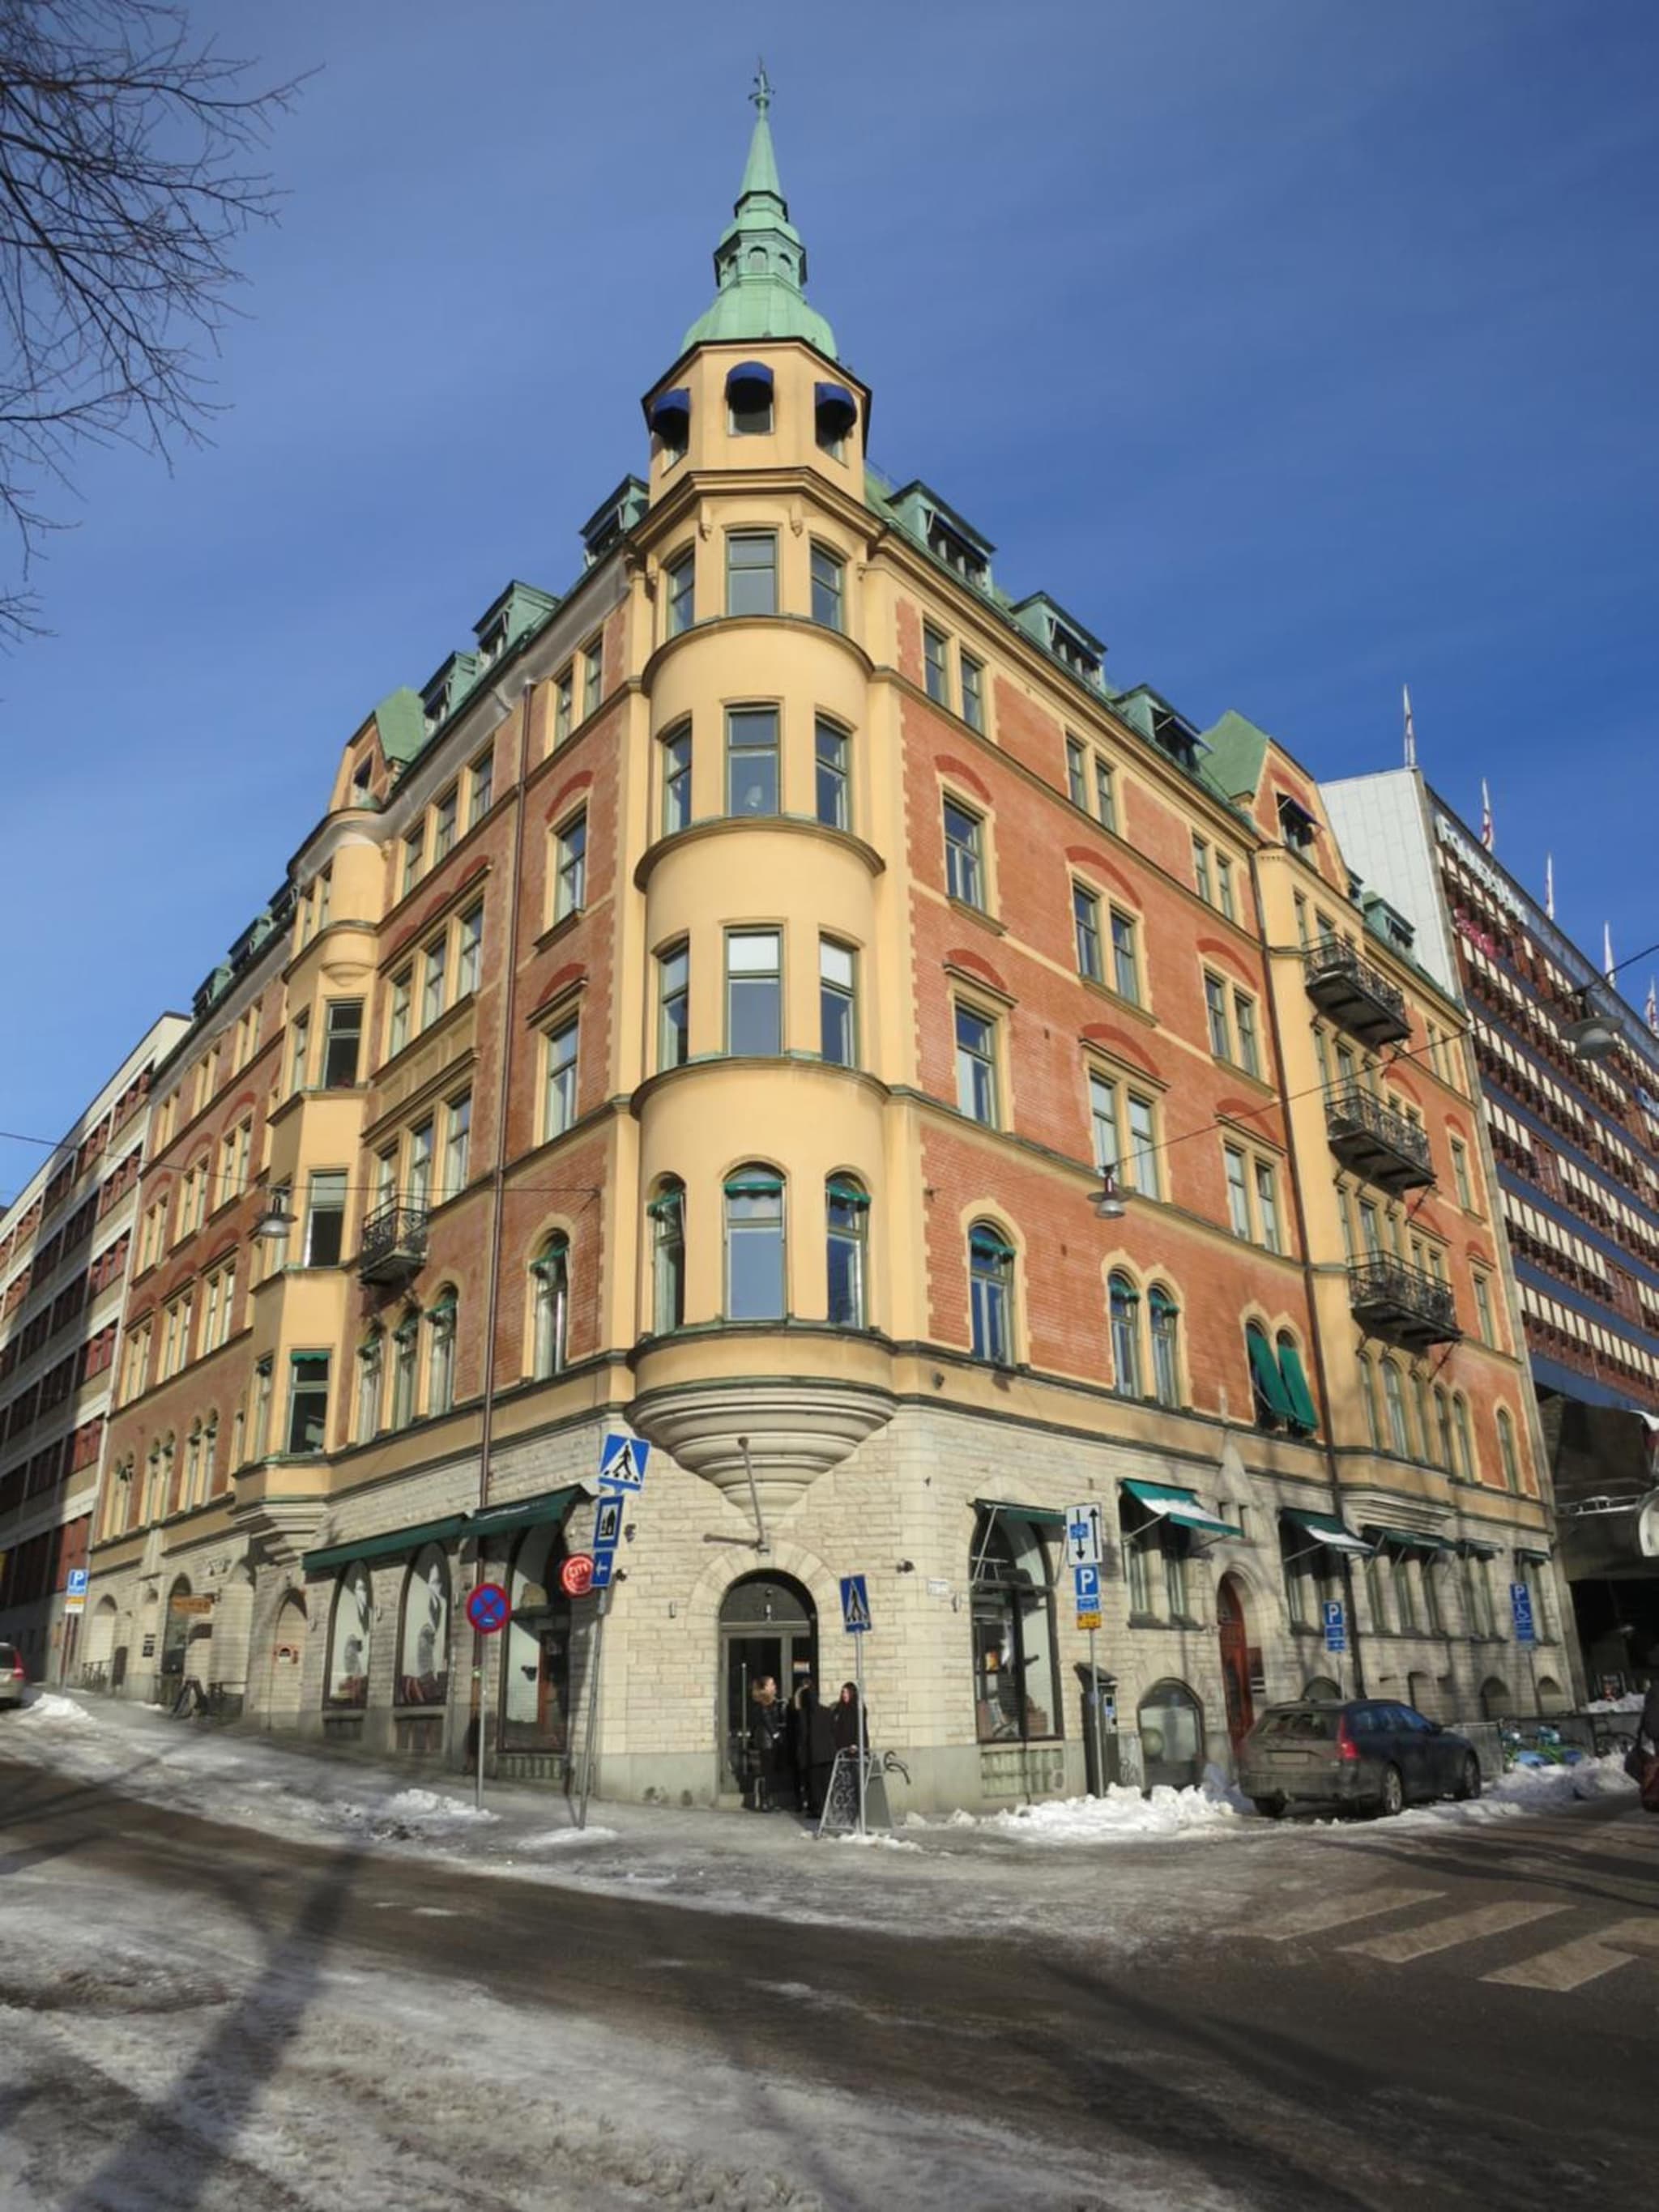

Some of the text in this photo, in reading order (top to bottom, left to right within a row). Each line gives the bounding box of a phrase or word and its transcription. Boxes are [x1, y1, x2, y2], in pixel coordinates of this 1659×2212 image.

[73, 1571, 84, 1586] P
[1080, 1569, 1094, 1593] P
[1514, 1585, 1525, 1600] P
[1328, 1604, 1339, 1624] P
